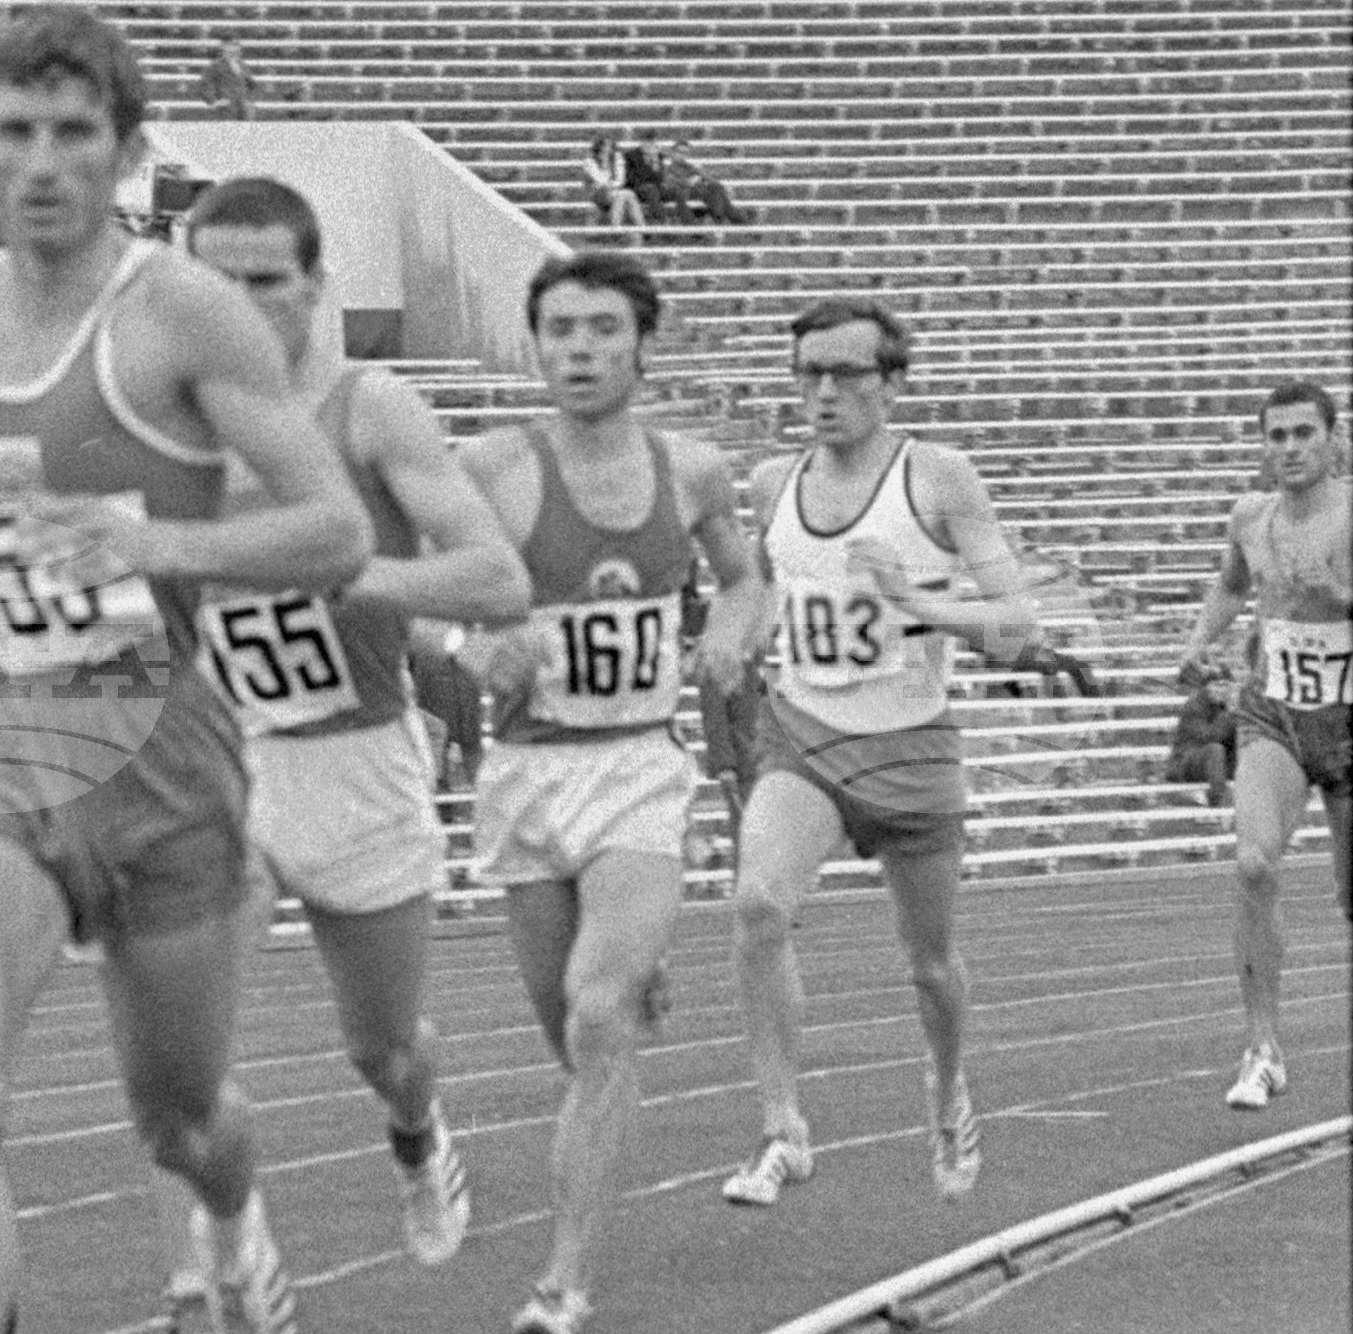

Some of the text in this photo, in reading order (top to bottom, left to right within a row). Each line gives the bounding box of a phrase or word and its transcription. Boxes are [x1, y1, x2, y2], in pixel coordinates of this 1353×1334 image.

[211, 598, 341, 706] 155
[560, 606, 662, 698] 160
[1280, 650, 1353, 704] 157
